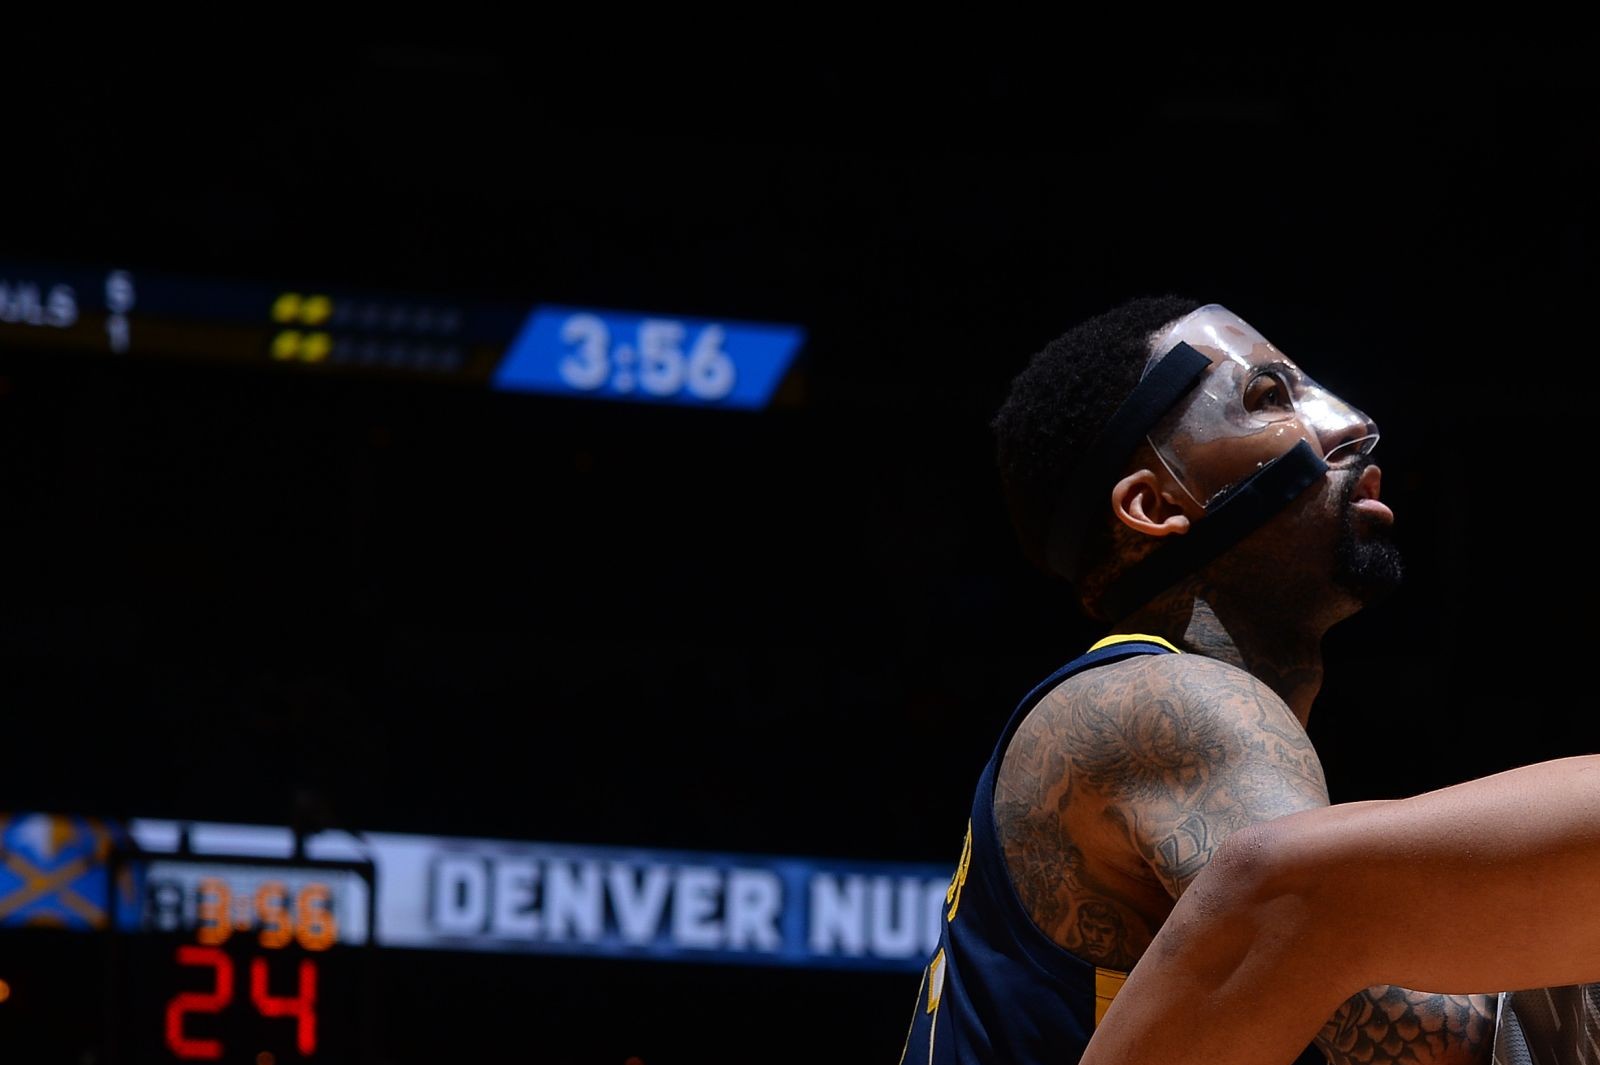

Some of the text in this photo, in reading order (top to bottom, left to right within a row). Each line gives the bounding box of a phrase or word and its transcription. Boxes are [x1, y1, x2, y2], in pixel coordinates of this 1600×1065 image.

[555, 309, 739, 402] 3:56
[195, 876, 338, 953] 3:56
[433, 856, 783, 955] DENVER
[162, 942, 321, 1063] 24
